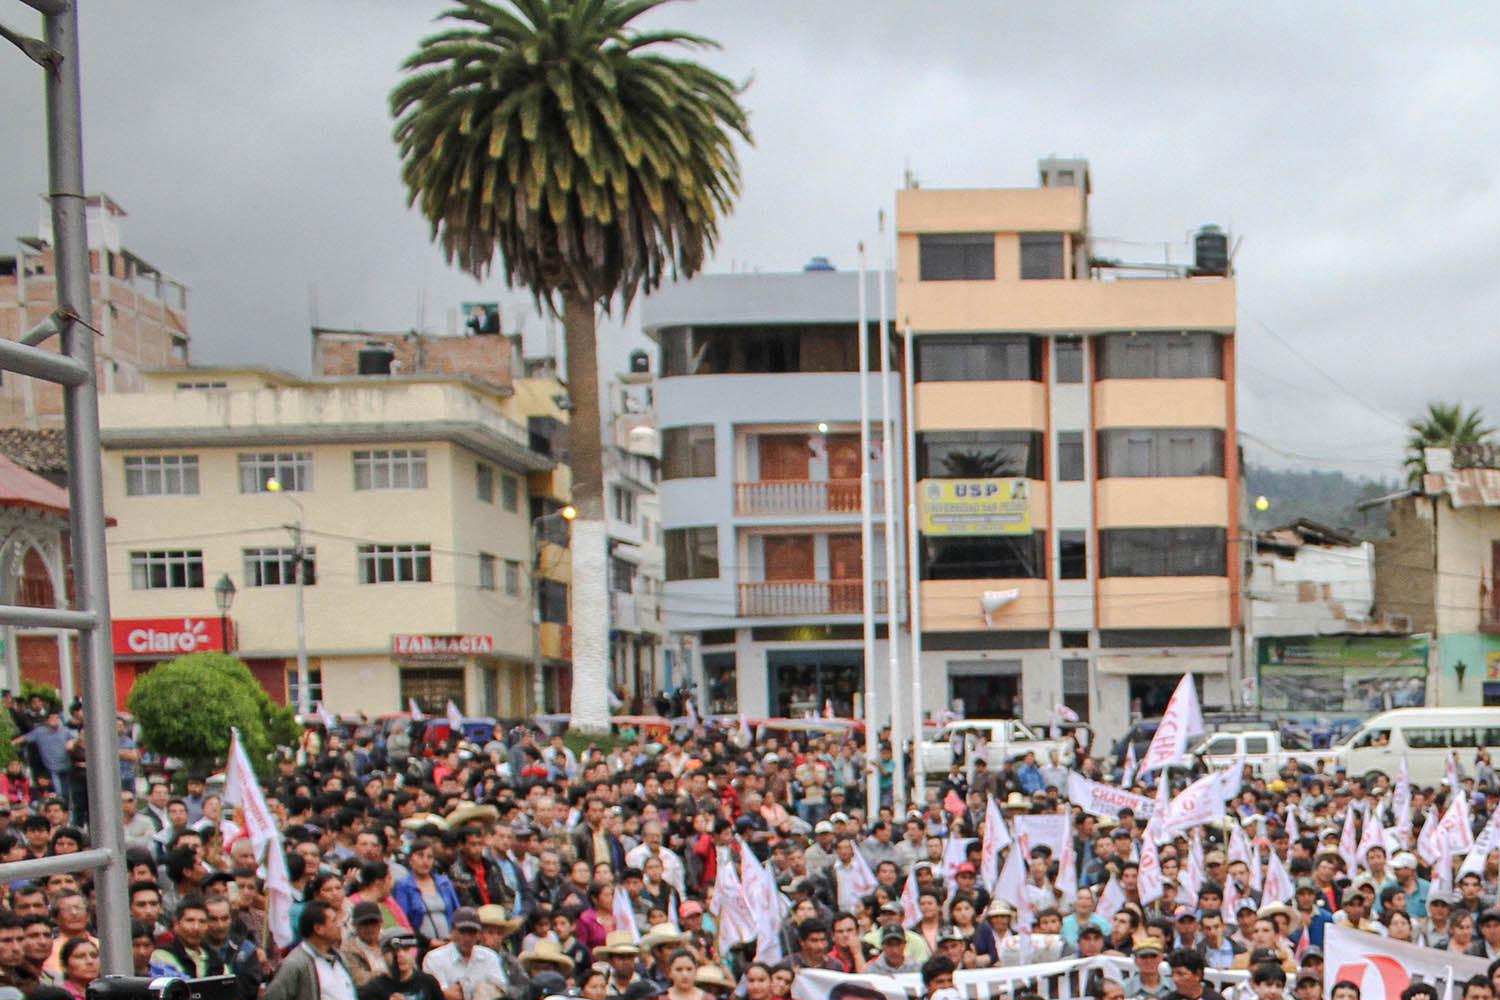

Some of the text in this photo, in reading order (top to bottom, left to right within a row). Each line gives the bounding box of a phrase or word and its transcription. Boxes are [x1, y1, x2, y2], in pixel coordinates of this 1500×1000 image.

[955, 484, 998, 497] USP
[128, 629, 196, 652] Claro
[397, 636, 491, 652] FARMACIA
